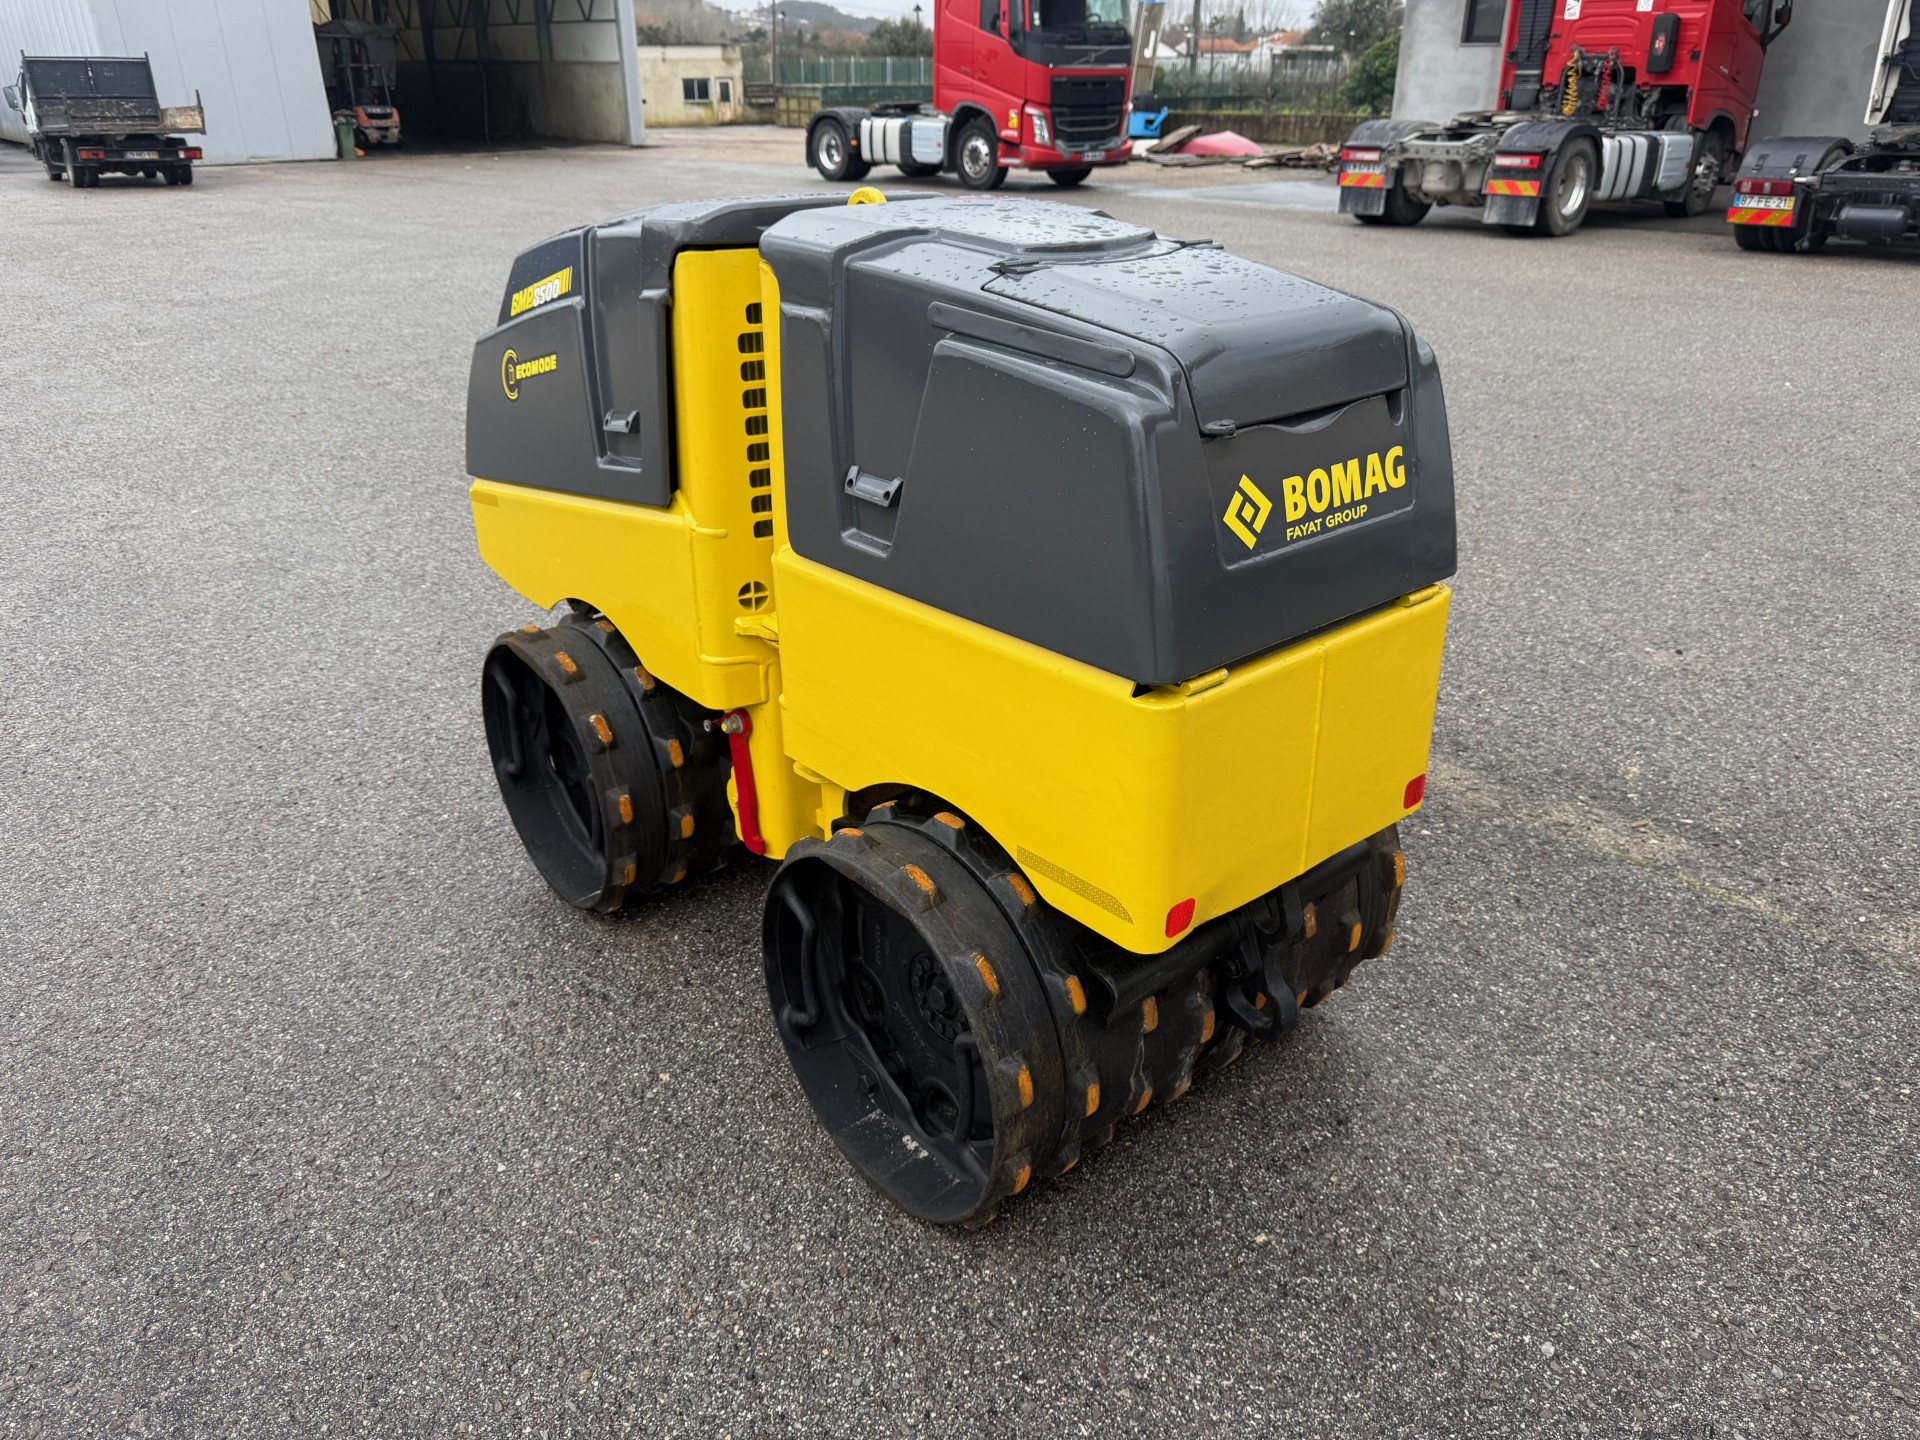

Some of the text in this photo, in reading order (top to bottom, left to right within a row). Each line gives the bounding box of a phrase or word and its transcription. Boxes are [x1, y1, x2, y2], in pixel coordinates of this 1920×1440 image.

[516, 354, 557, 380] ECOMODE
[1282, 445, 1406, 523] BOMAG
[1286, 504, 1368, 541] FAYAT GROUP
